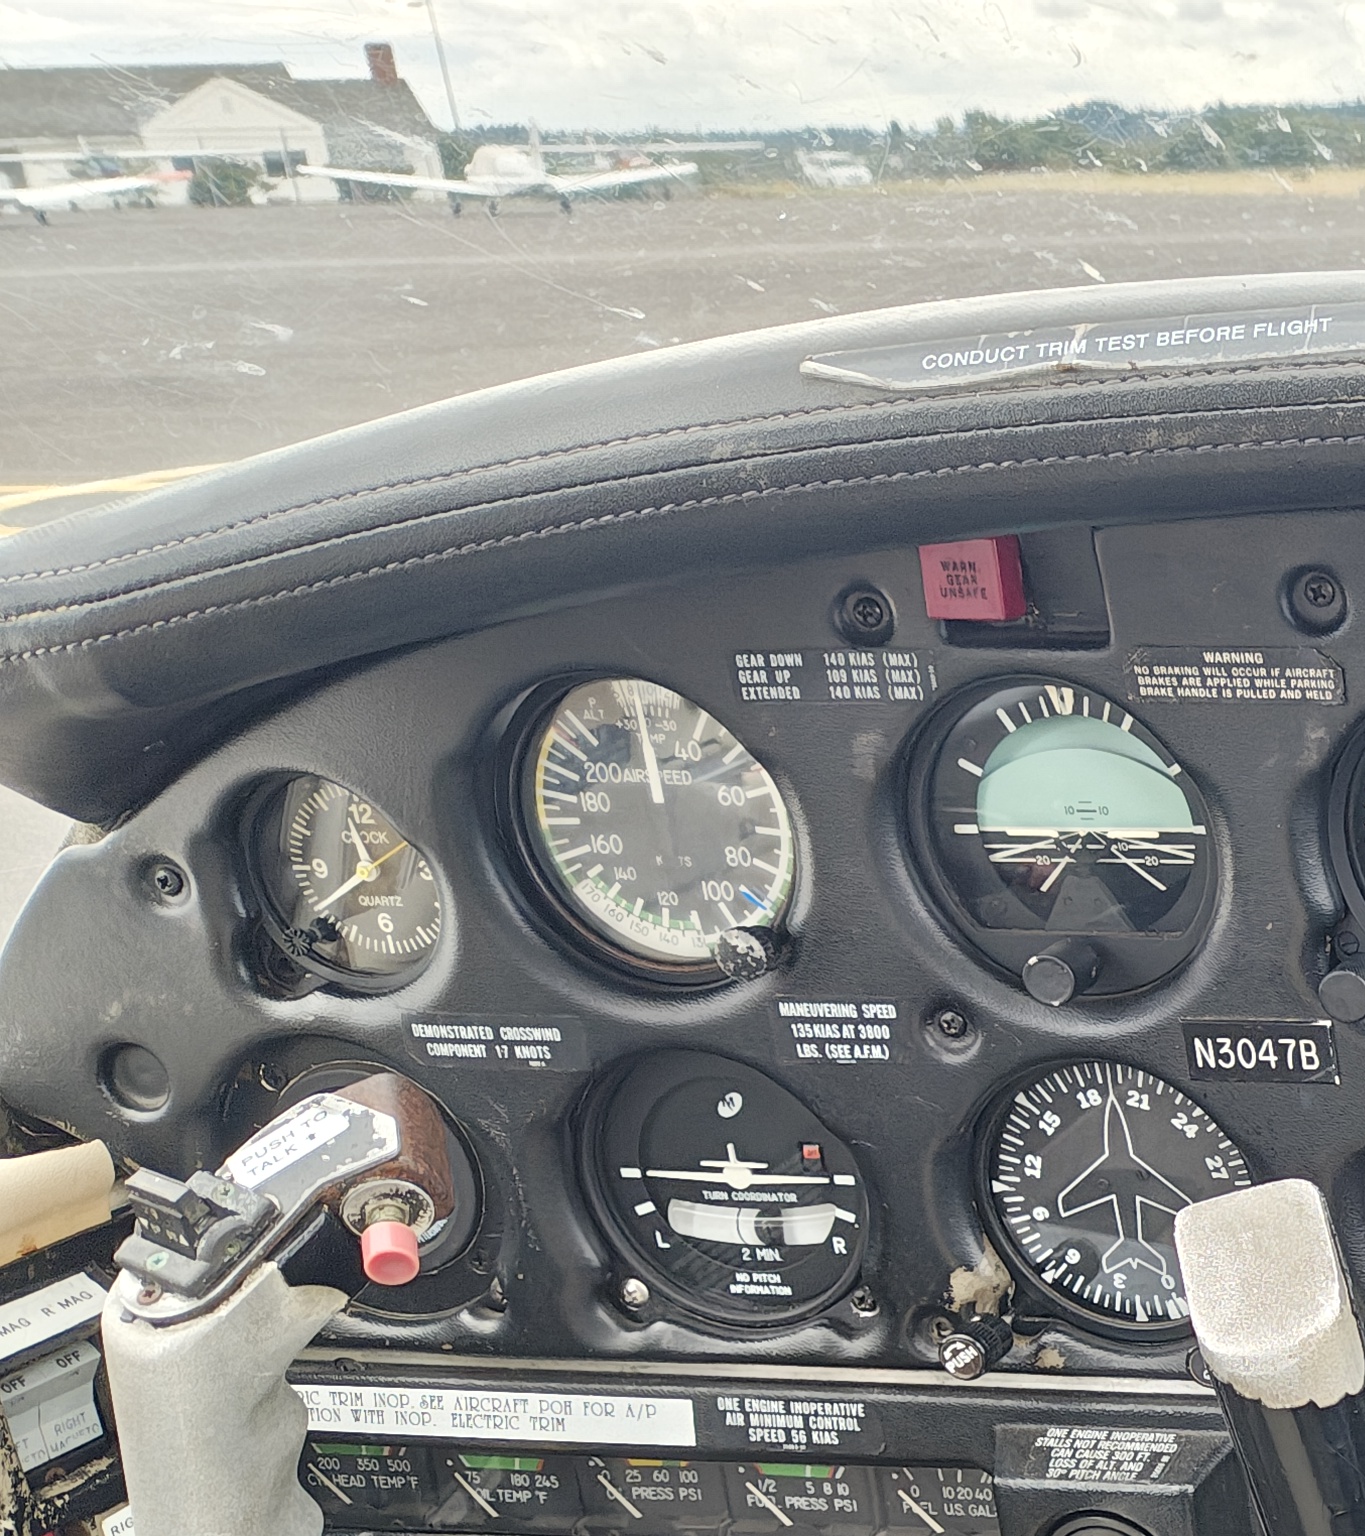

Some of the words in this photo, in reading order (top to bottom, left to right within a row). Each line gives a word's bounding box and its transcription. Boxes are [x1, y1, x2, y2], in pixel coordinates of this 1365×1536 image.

[921, 344, 1030, 370] CONDUCT
[1036, 338, 1086, 358] TRIM
[1094, 332, 1150, 352] TEST
[1156, 324, 1246, 347] BEFORE
[1253, 318, 1333, 340] FLIGHT
[735, 653, 766, 668] GEAR
[769, 652, 803, 668] DOWN
[822, 652, 846, 667] 140
[848, 652, 876, 667] KIAS
[882, 652, 918, 668] (MAX)
[1202, 651, 1264, 664] WARNING
[583, 761, 623, 784] 200
[358, 894, 404, 908] QUARTZ
[701, 880, 735, 902] 100
[778, 1001, 858, 1019] MANEUVERING
[861, 1003, 897, 1019] SPEED
[410, 1023, 494, 1040] DEMONSTRATED
[499, 1026, 562, 1042] CROSSWIND
[426, 1042, 487, 1058] COMPONENT
[513, 1045, 552, 1060] KNOTS
[1194, 1037, 1320, 1070] N3047B
[946, 1348, 978, 1373] PUSH
[328, 1391, 364, 1407] TRIM
[454, 1396, 529, 1414] AIRCRAFT
[582, 1401, 616, 1418] FOR
[716, 1396, 741, 1412] ONE
[744, 1397, 786, 1414] ENGINE
[789, 1400, 866, 1418] INOPERATIVE
